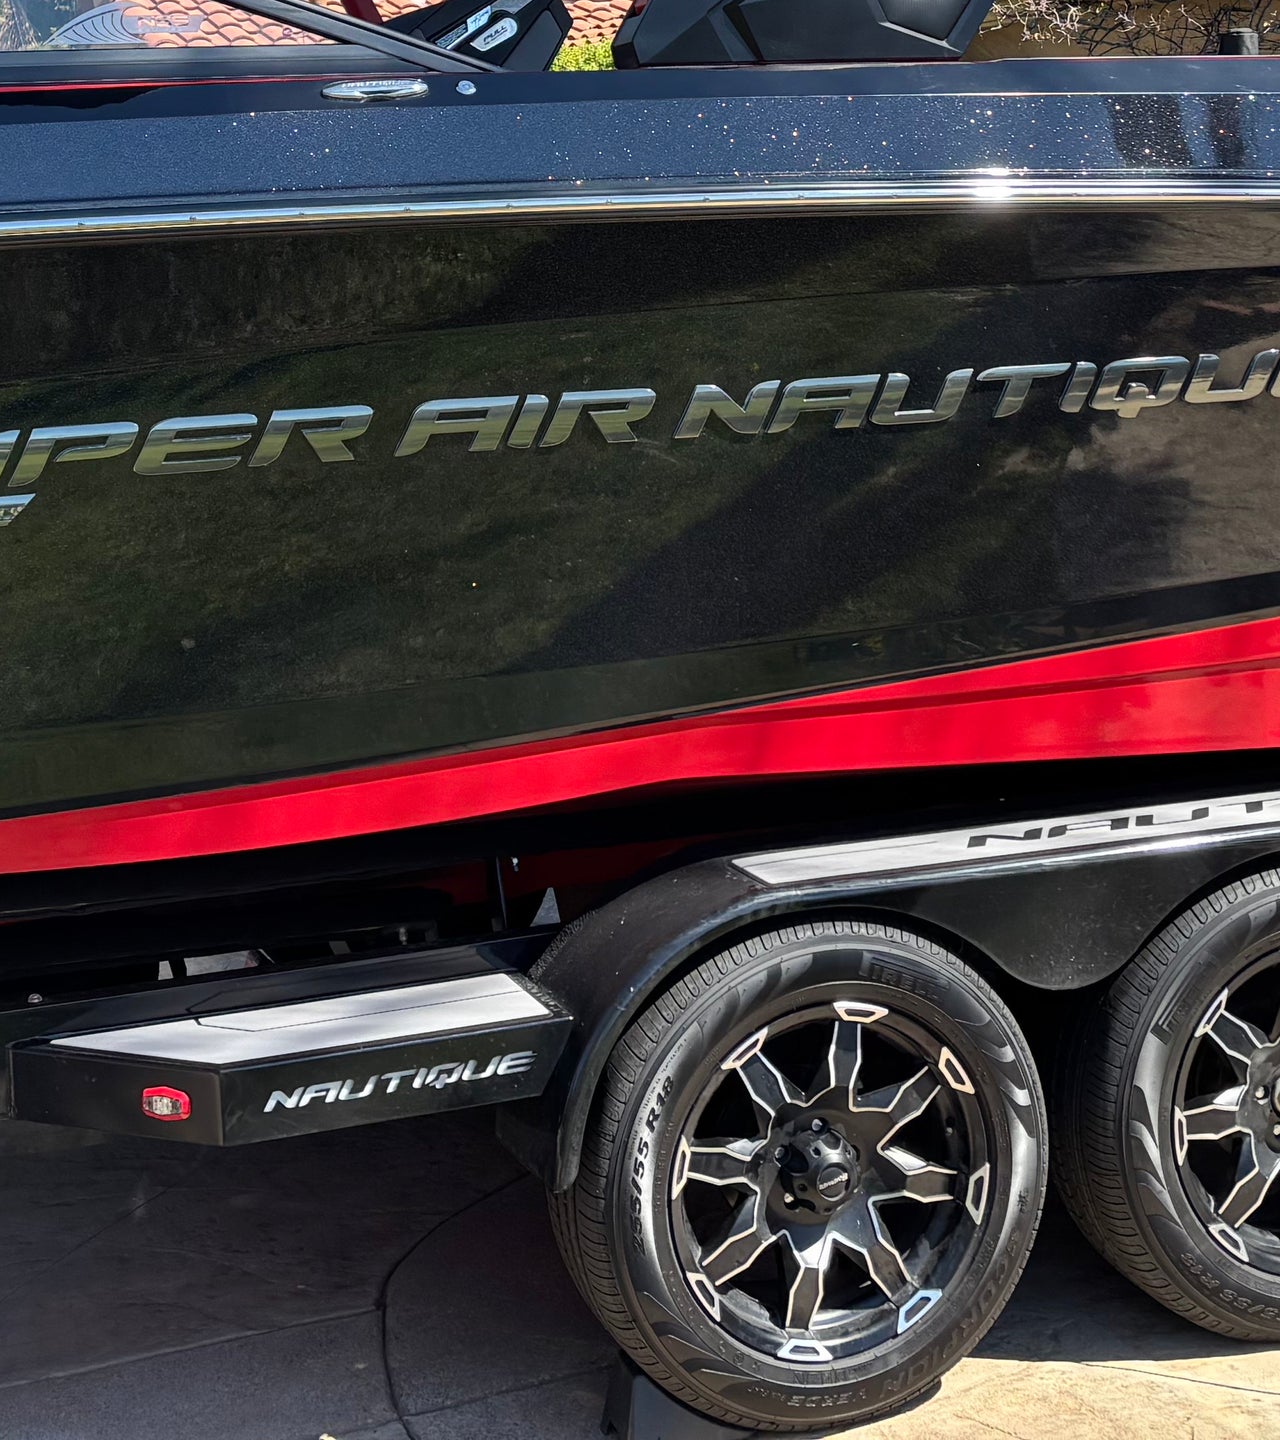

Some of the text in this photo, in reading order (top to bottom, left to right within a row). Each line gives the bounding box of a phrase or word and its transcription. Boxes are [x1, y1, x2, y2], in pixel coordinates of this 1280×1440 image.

[483, 24, 507, 42] PULL
[394, 387, 657, 457] AIR
[263, 1051, 538, 1113] NAUTIQUE
[628, 1137, 650, 1257] 255/55
[645, 1076, 674, 1133] R18
